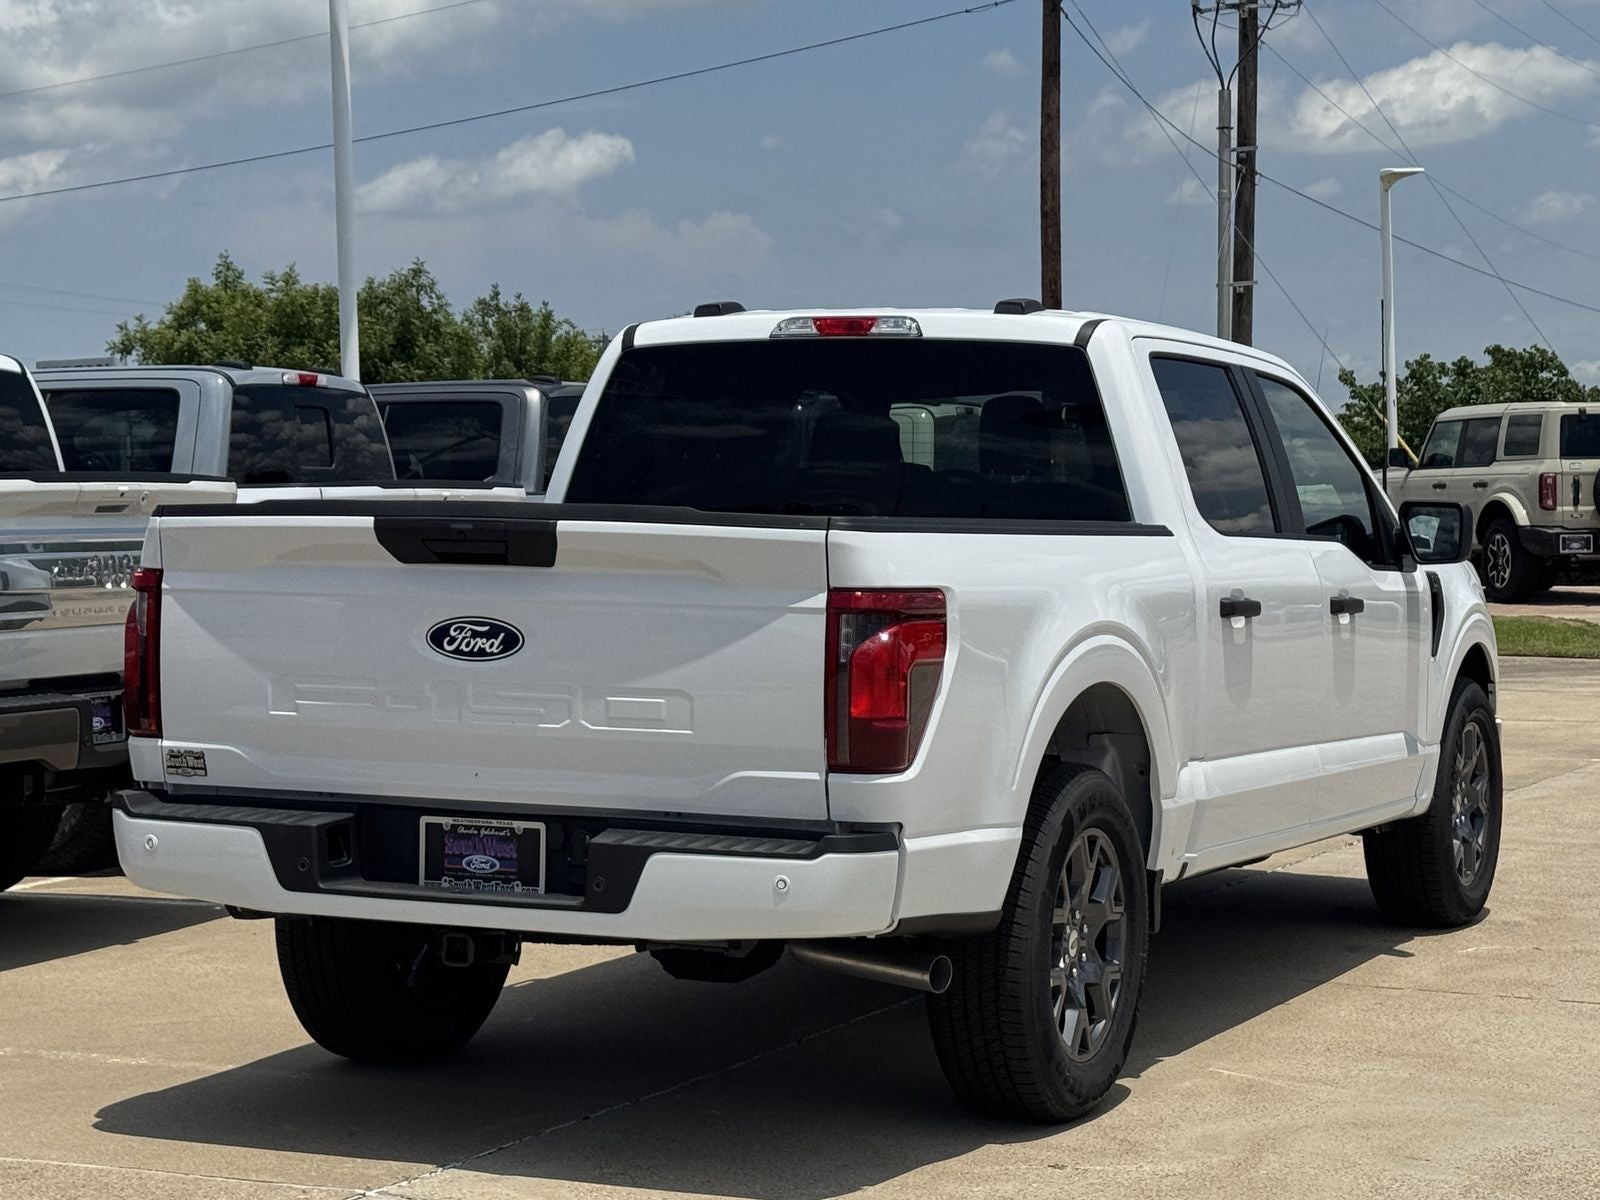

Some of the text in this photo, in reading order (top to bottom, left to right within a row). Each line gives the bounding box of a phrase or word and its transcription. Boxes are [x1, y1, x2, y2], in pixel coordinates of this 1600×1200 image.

[443, 623, 505, 653] Ford
[267, 675, 695, 733] F-150
[470, 857, 492, 870] Ford
